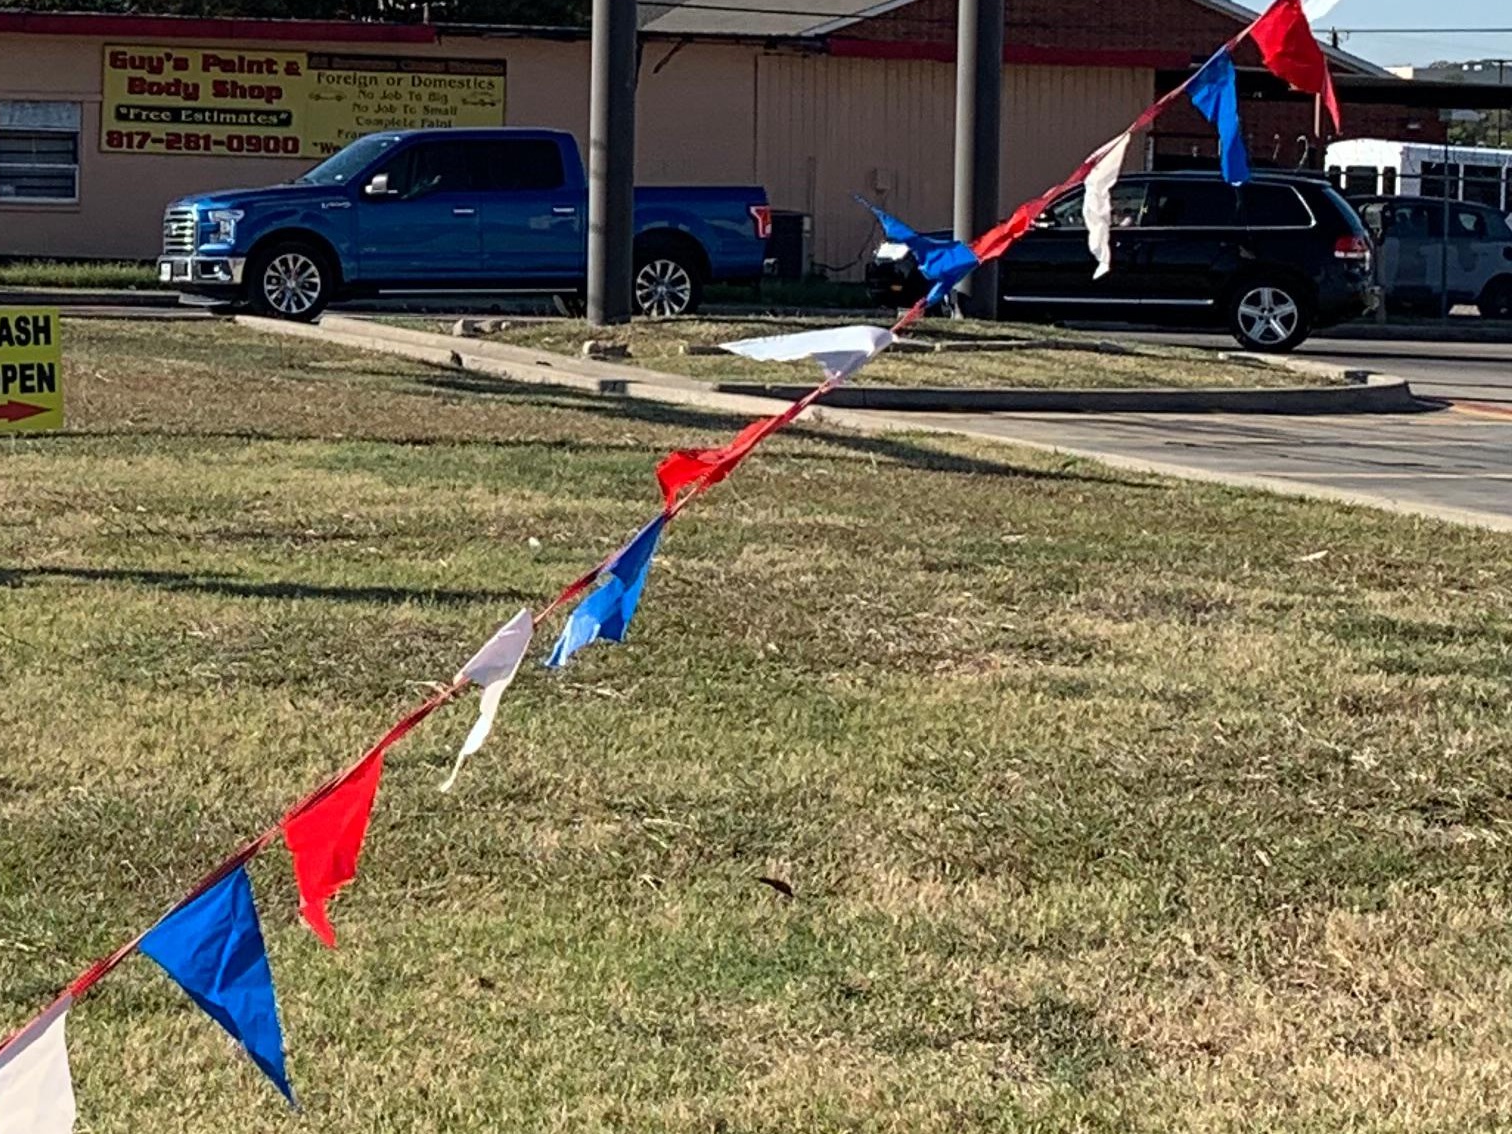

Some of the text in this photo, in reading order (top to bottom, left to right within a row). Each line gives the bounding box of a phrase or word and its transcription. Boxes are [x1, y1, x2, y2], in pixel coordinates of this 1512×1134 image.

[109, 51, 190, 75] Guy's
[201, 53, 279, 75] Paint
[284, 60, 302, 76] &
[127, 76, 283, 104] Body Shop
[316, 72, 495, 90] Foreign or Domestics
[106, 130, 300, 154] 817-281-0900
